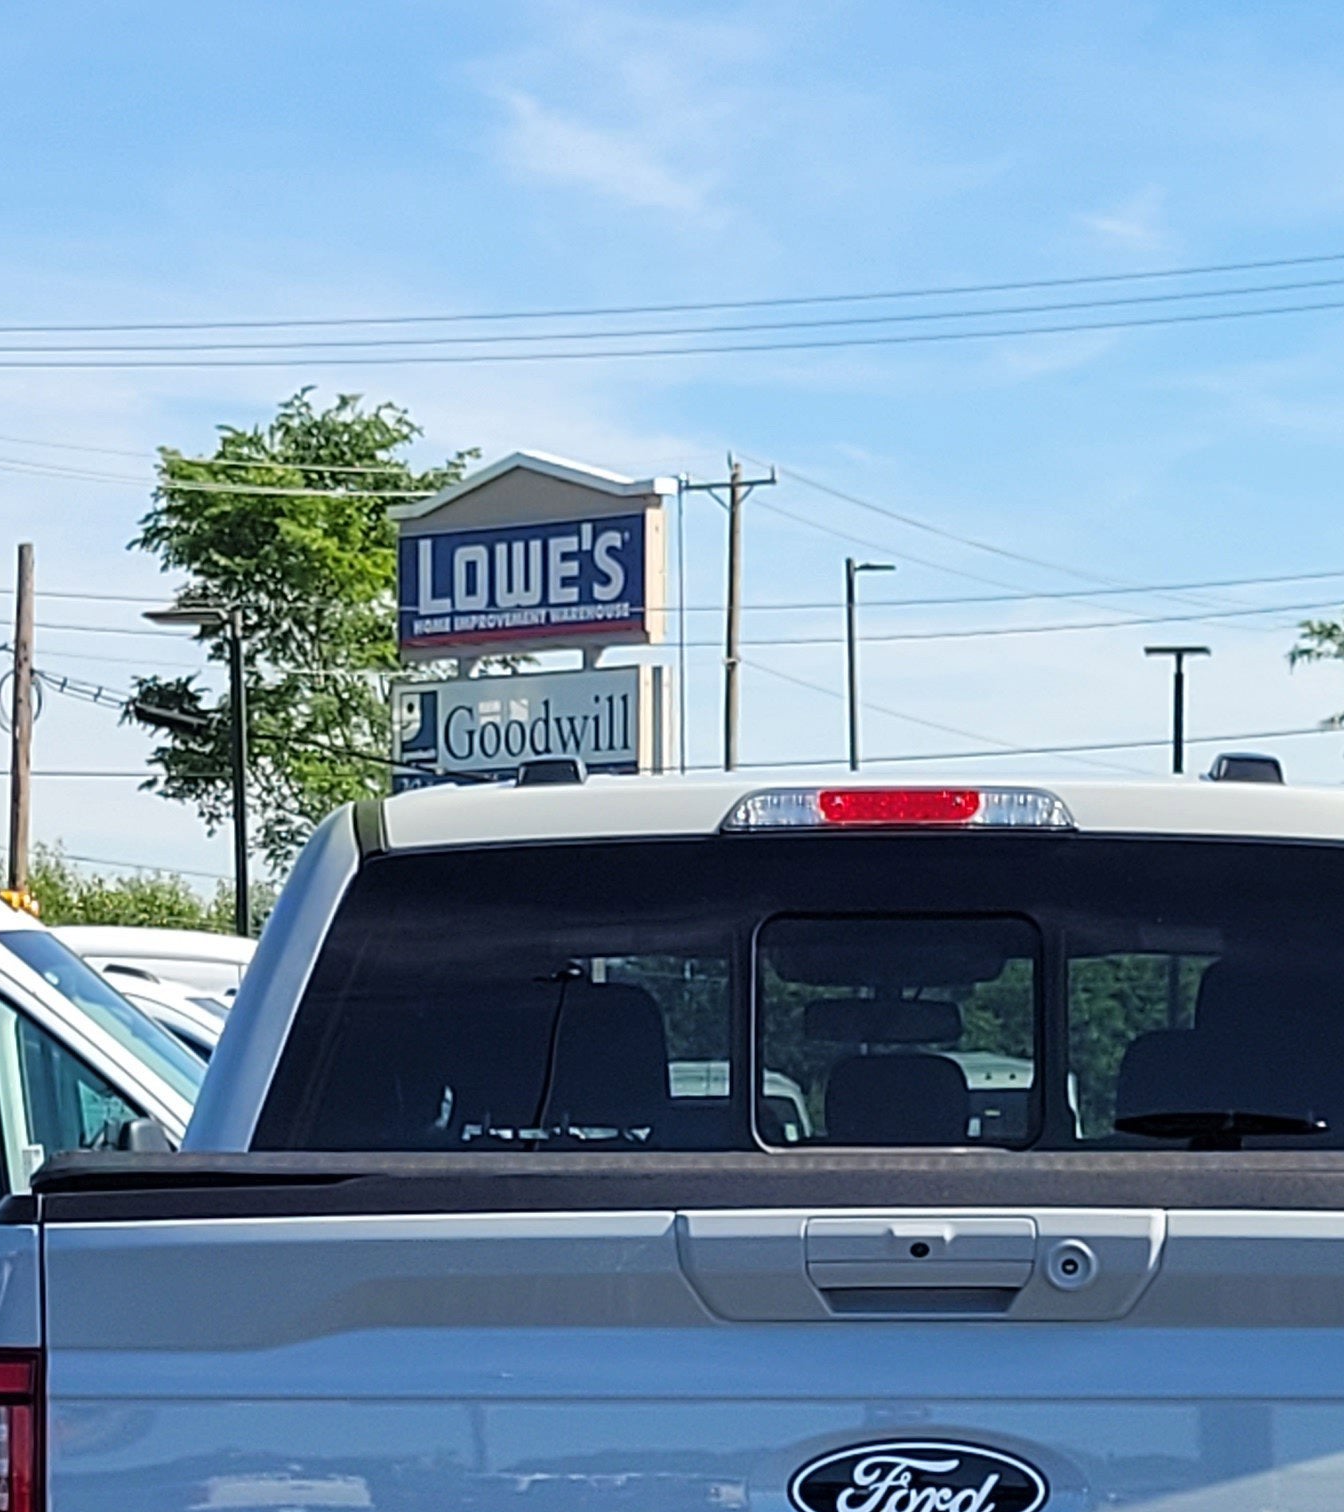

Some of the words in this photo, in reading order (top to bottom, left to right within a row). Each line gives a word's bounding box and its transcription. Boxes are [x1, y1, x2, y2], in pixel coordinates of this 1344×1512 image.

[418, 522, 626, 616] LOWE'S
[413, 616, 451, 635] HOME
[453, 609, 547, 632] IMPROVEMENT
[549, 602, 630, 624] WAREHOUSE
[443, 692, 632, 761] Goodwill
